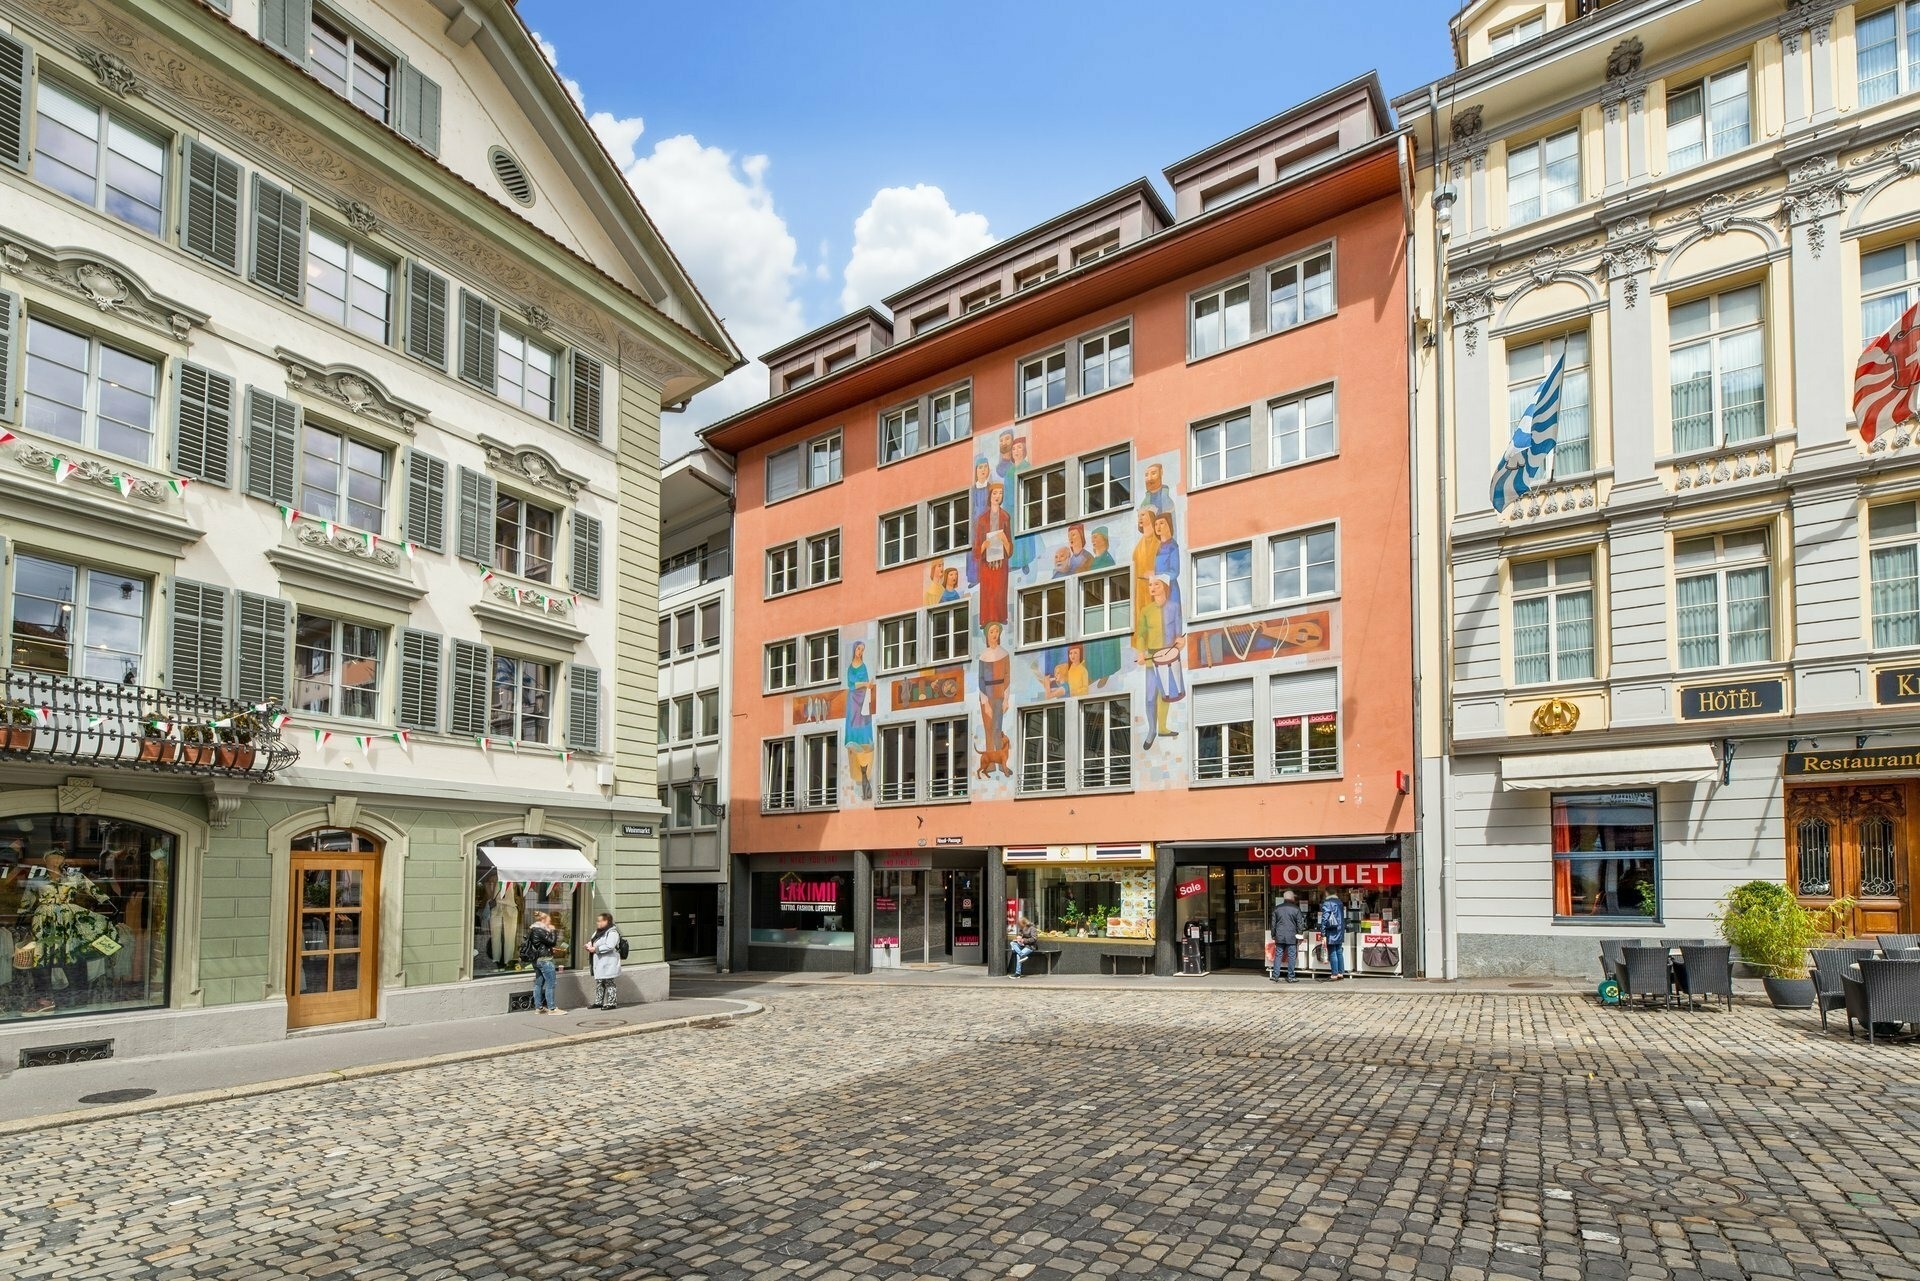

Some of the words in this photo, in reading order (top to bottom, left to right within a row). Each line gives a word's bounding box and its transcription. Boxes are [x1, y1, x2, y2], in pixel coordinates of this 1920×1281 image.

[625, 826, 651, 834] Weinmarkt
[1254, 846, 1309, 858] bodum
[1283, 864, 1389, 884] OUTLET
[1179, 883, 1202, 896] Sale
